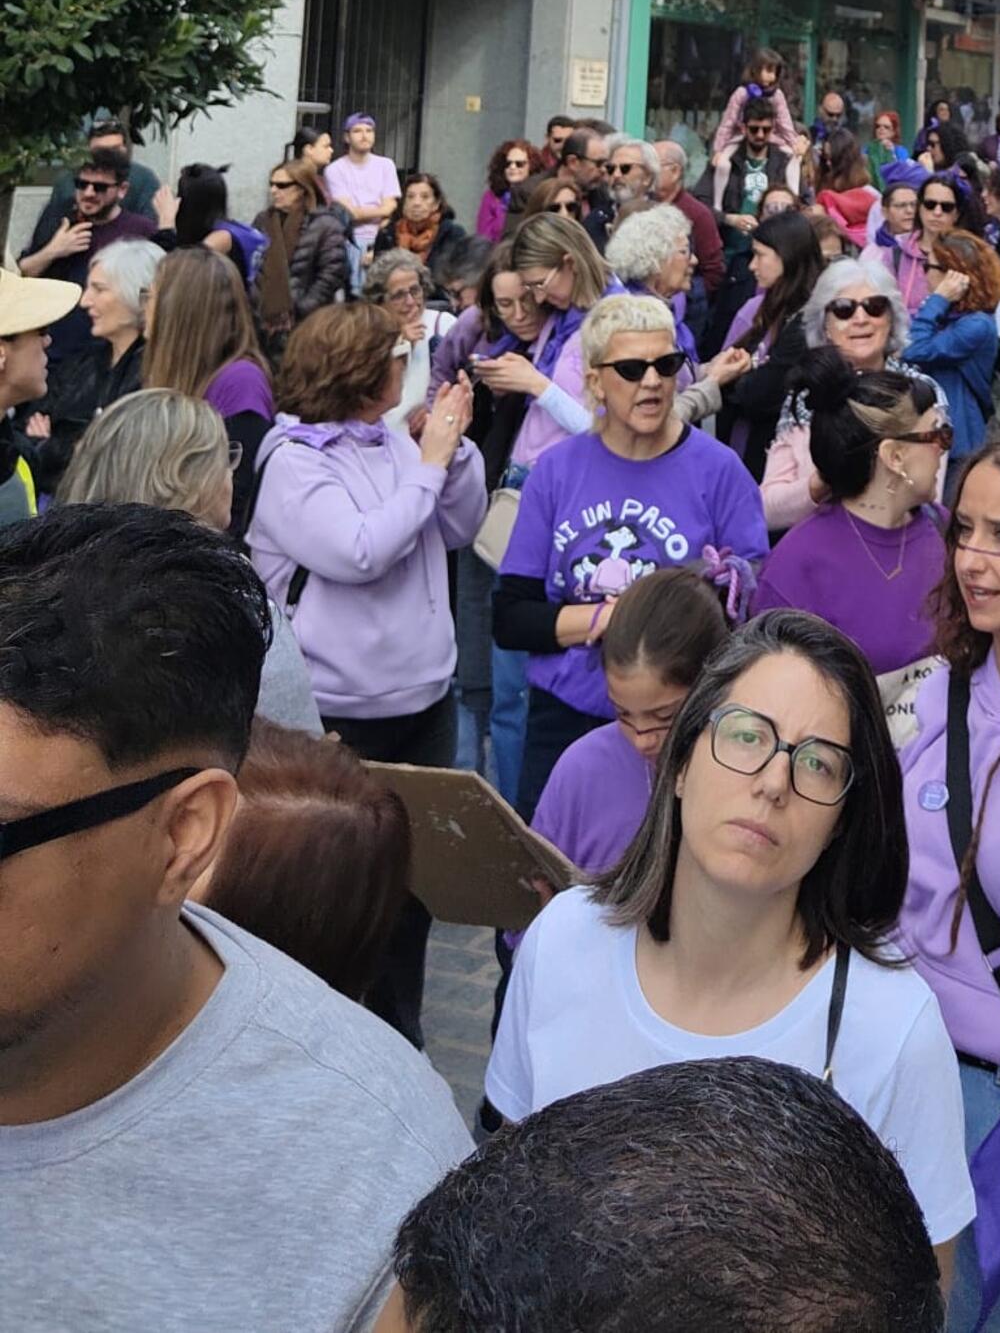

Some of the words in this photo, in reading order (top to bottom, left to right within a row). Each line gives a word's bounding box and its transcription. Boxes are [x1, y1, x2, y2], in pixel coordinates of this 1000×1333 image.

[554, 520, 579, 552] NI
[582, 501, 612, 528] UN
[620, 499, 689, 560] PASO
